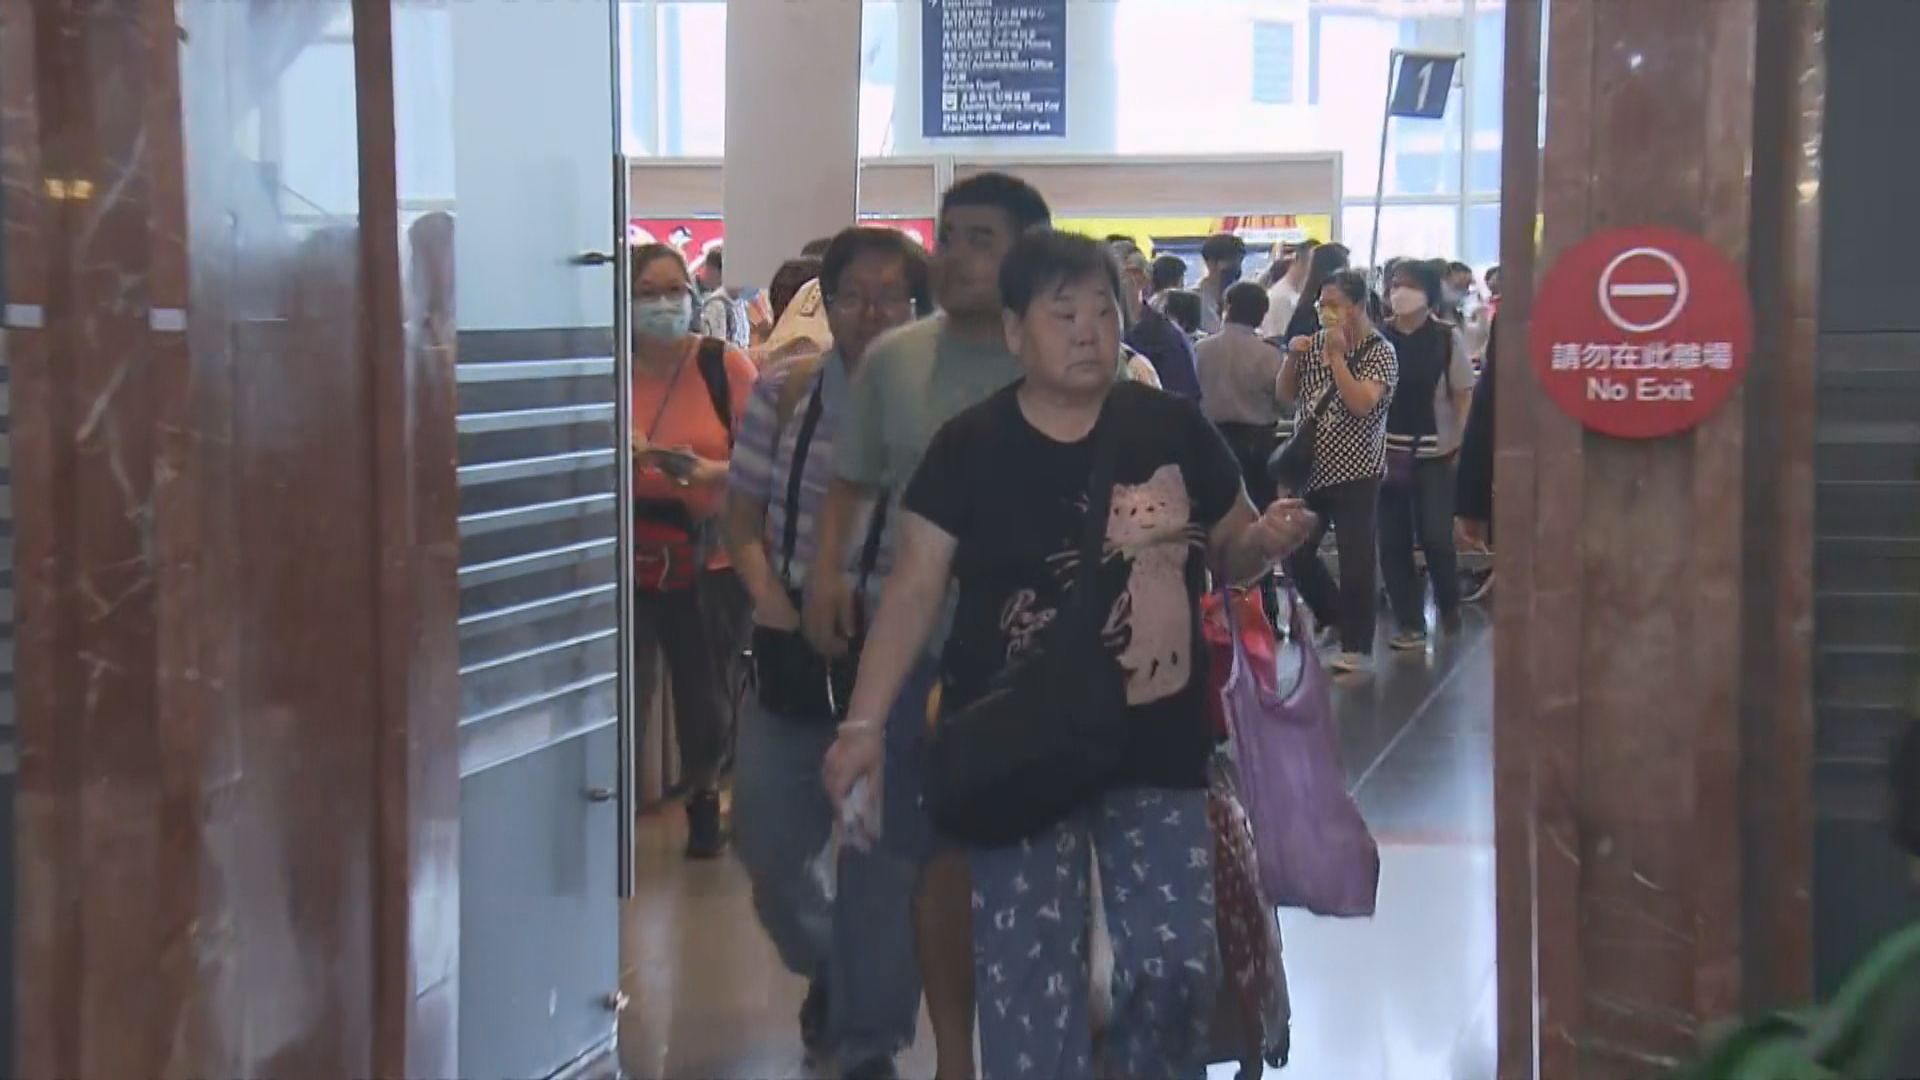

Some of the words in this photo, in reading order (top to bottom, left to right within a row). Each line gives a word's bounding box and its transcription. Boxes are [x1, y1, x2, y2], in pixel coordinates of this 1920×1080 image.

[1417, 59, 1435, 112] 1
[1551, 342, 1733, 370] 請勿在此離場
[1587, 377, 1628, 400] No
[1637, 377, 1694, 401] Exit
